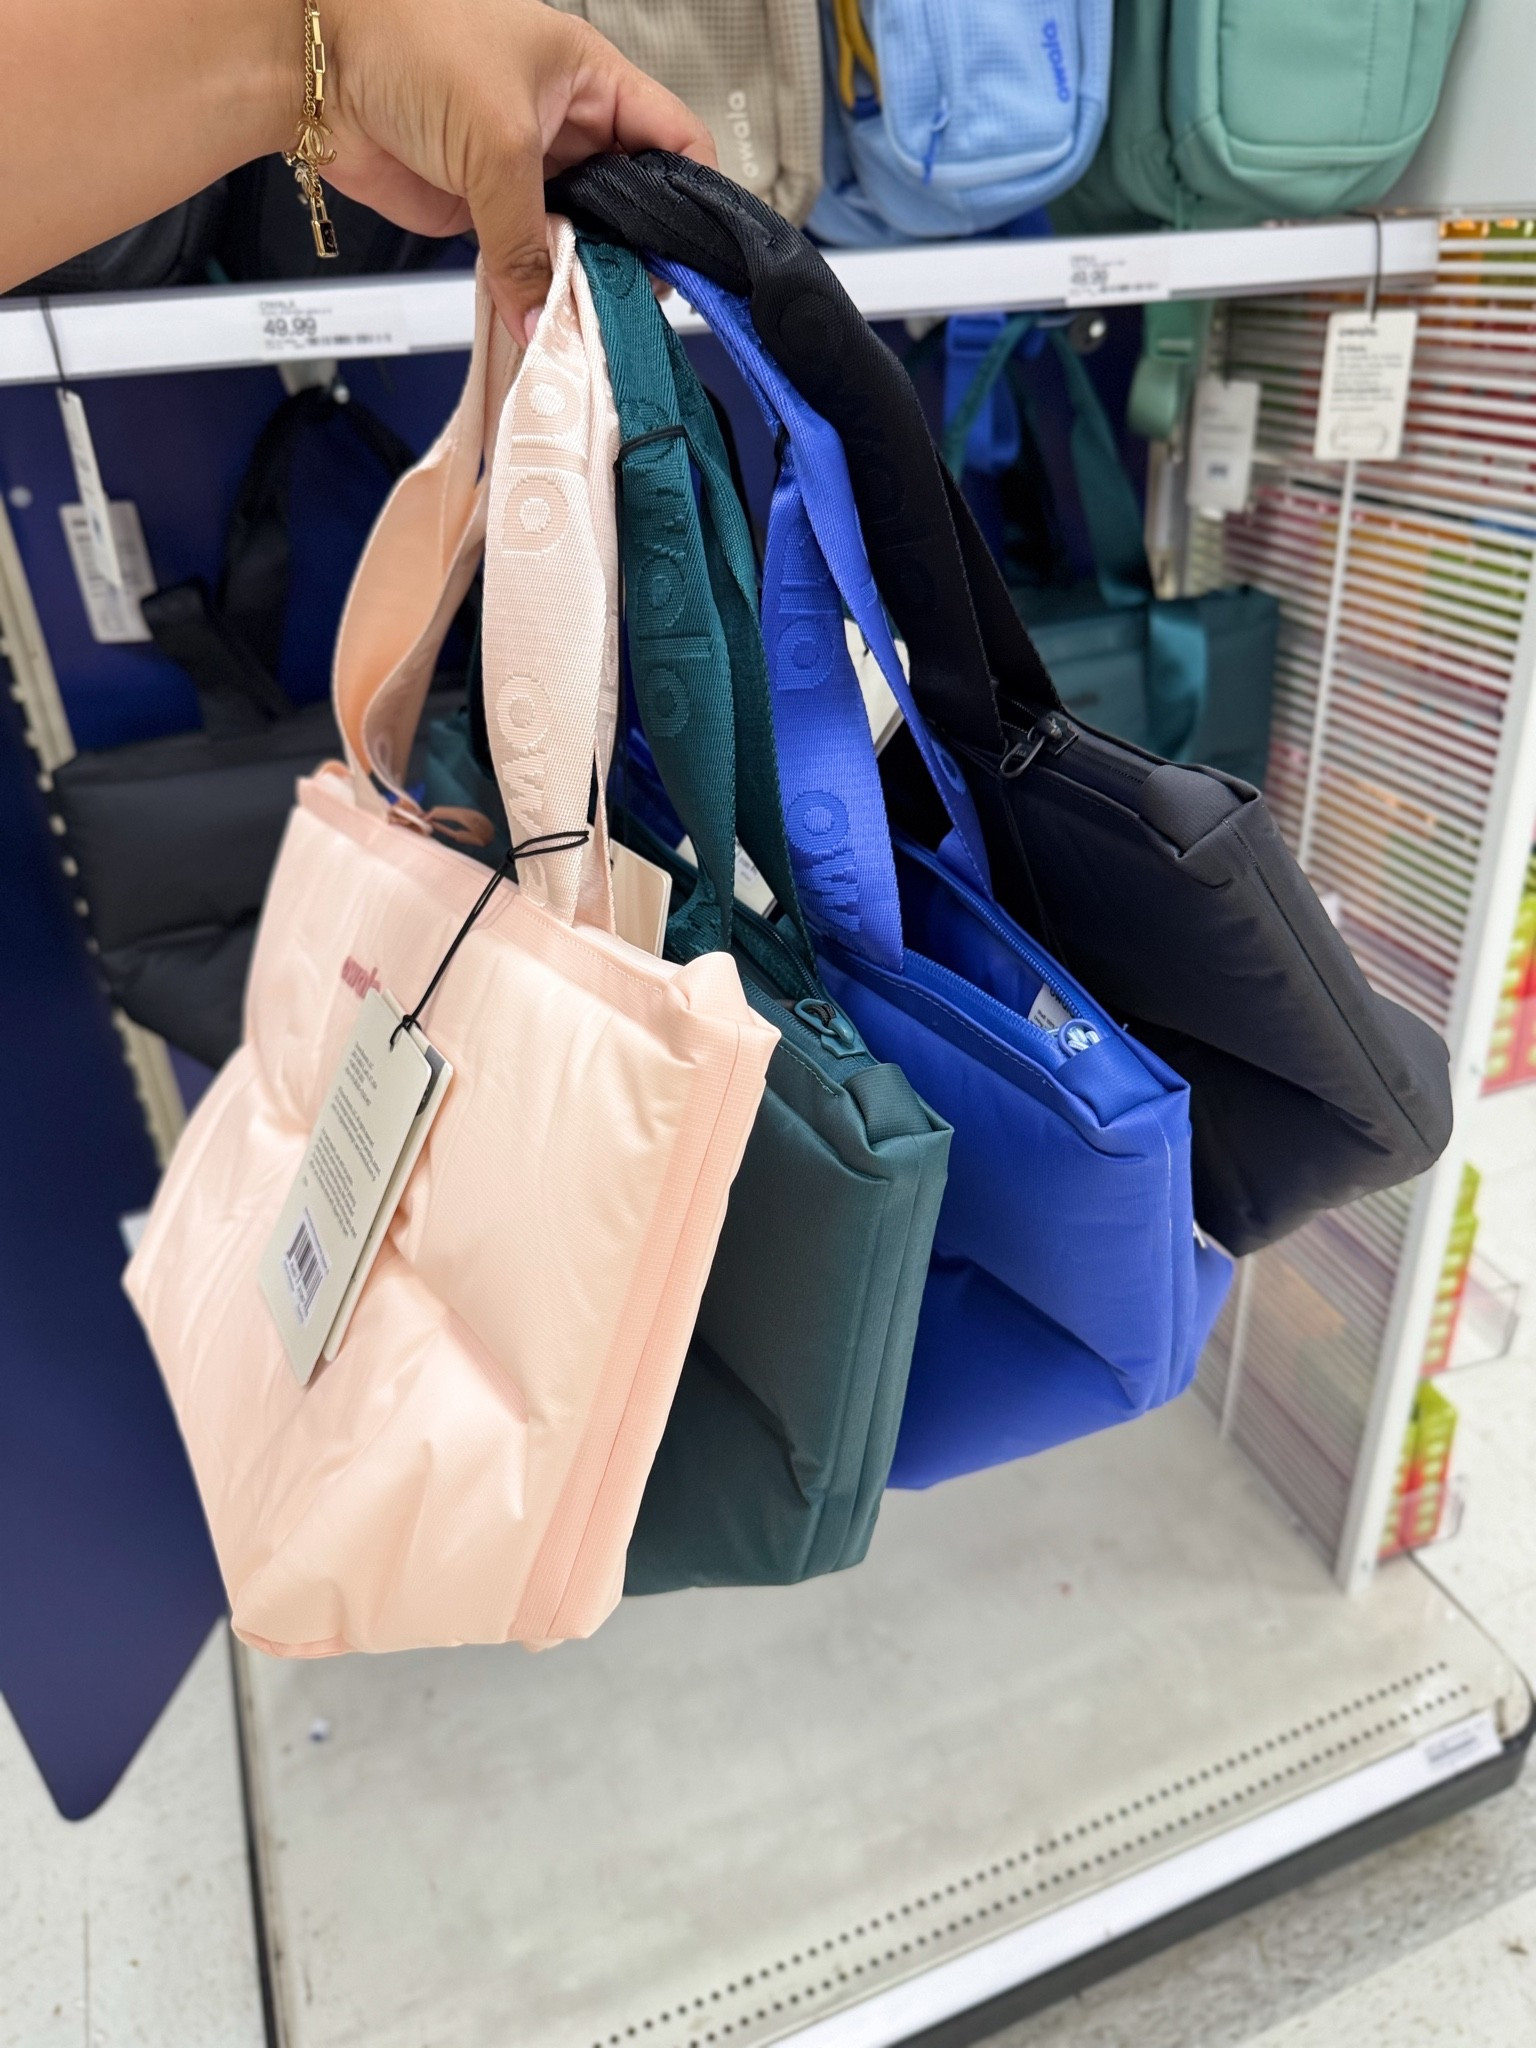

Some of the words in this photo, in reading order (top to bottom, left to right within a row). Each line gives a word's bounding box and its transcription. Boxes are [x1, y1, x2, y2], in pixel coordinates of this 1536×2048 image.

[1041, 20, 1071, 103] owala
[727, 90, 760, 180] owala
[263, 316, 318, 338] 49.99
